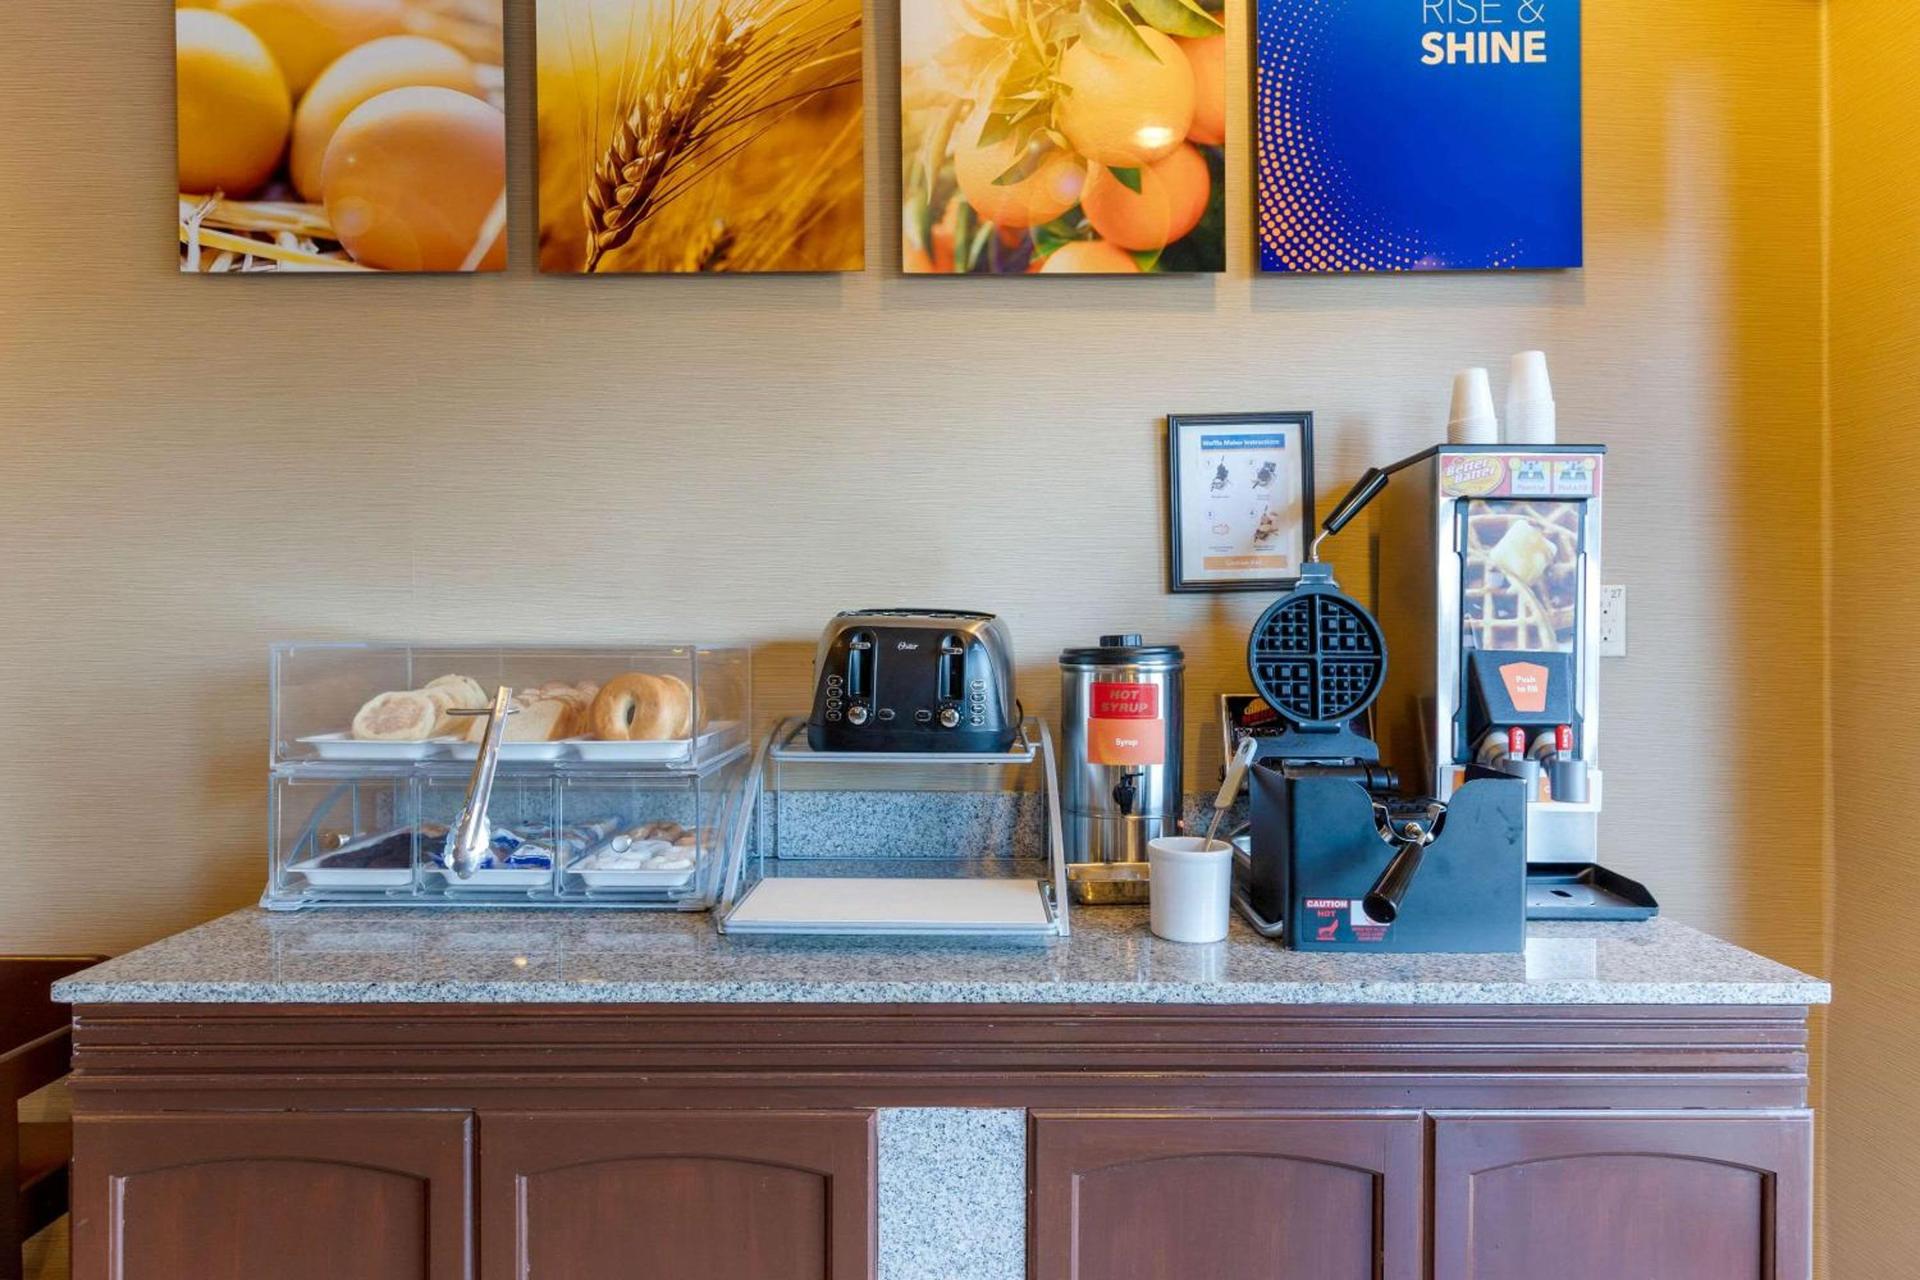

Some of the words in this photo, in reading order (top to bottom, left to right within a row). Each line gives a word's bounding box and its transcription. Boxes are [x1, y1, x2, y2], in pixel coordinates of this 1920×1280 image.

[1423, 0, 1503, 24] RISE
[1517, 0, 1545, 24] &
[1420, 30, 1548, 65] SHINE
[1223, 439, 1243, 447] Maker
[1610, 588, 1623, 599] 27
[1515, 674, 1537, 683] Push
[1110, 689, 1140, 700] HOT
[1101, 701, 1149, 713] SYRUP
[1114, 737, 1139, 748] Syrup
[1306, 899, 1348, 908] CAUTION
[1317, 909, 1337, 917] HOT
